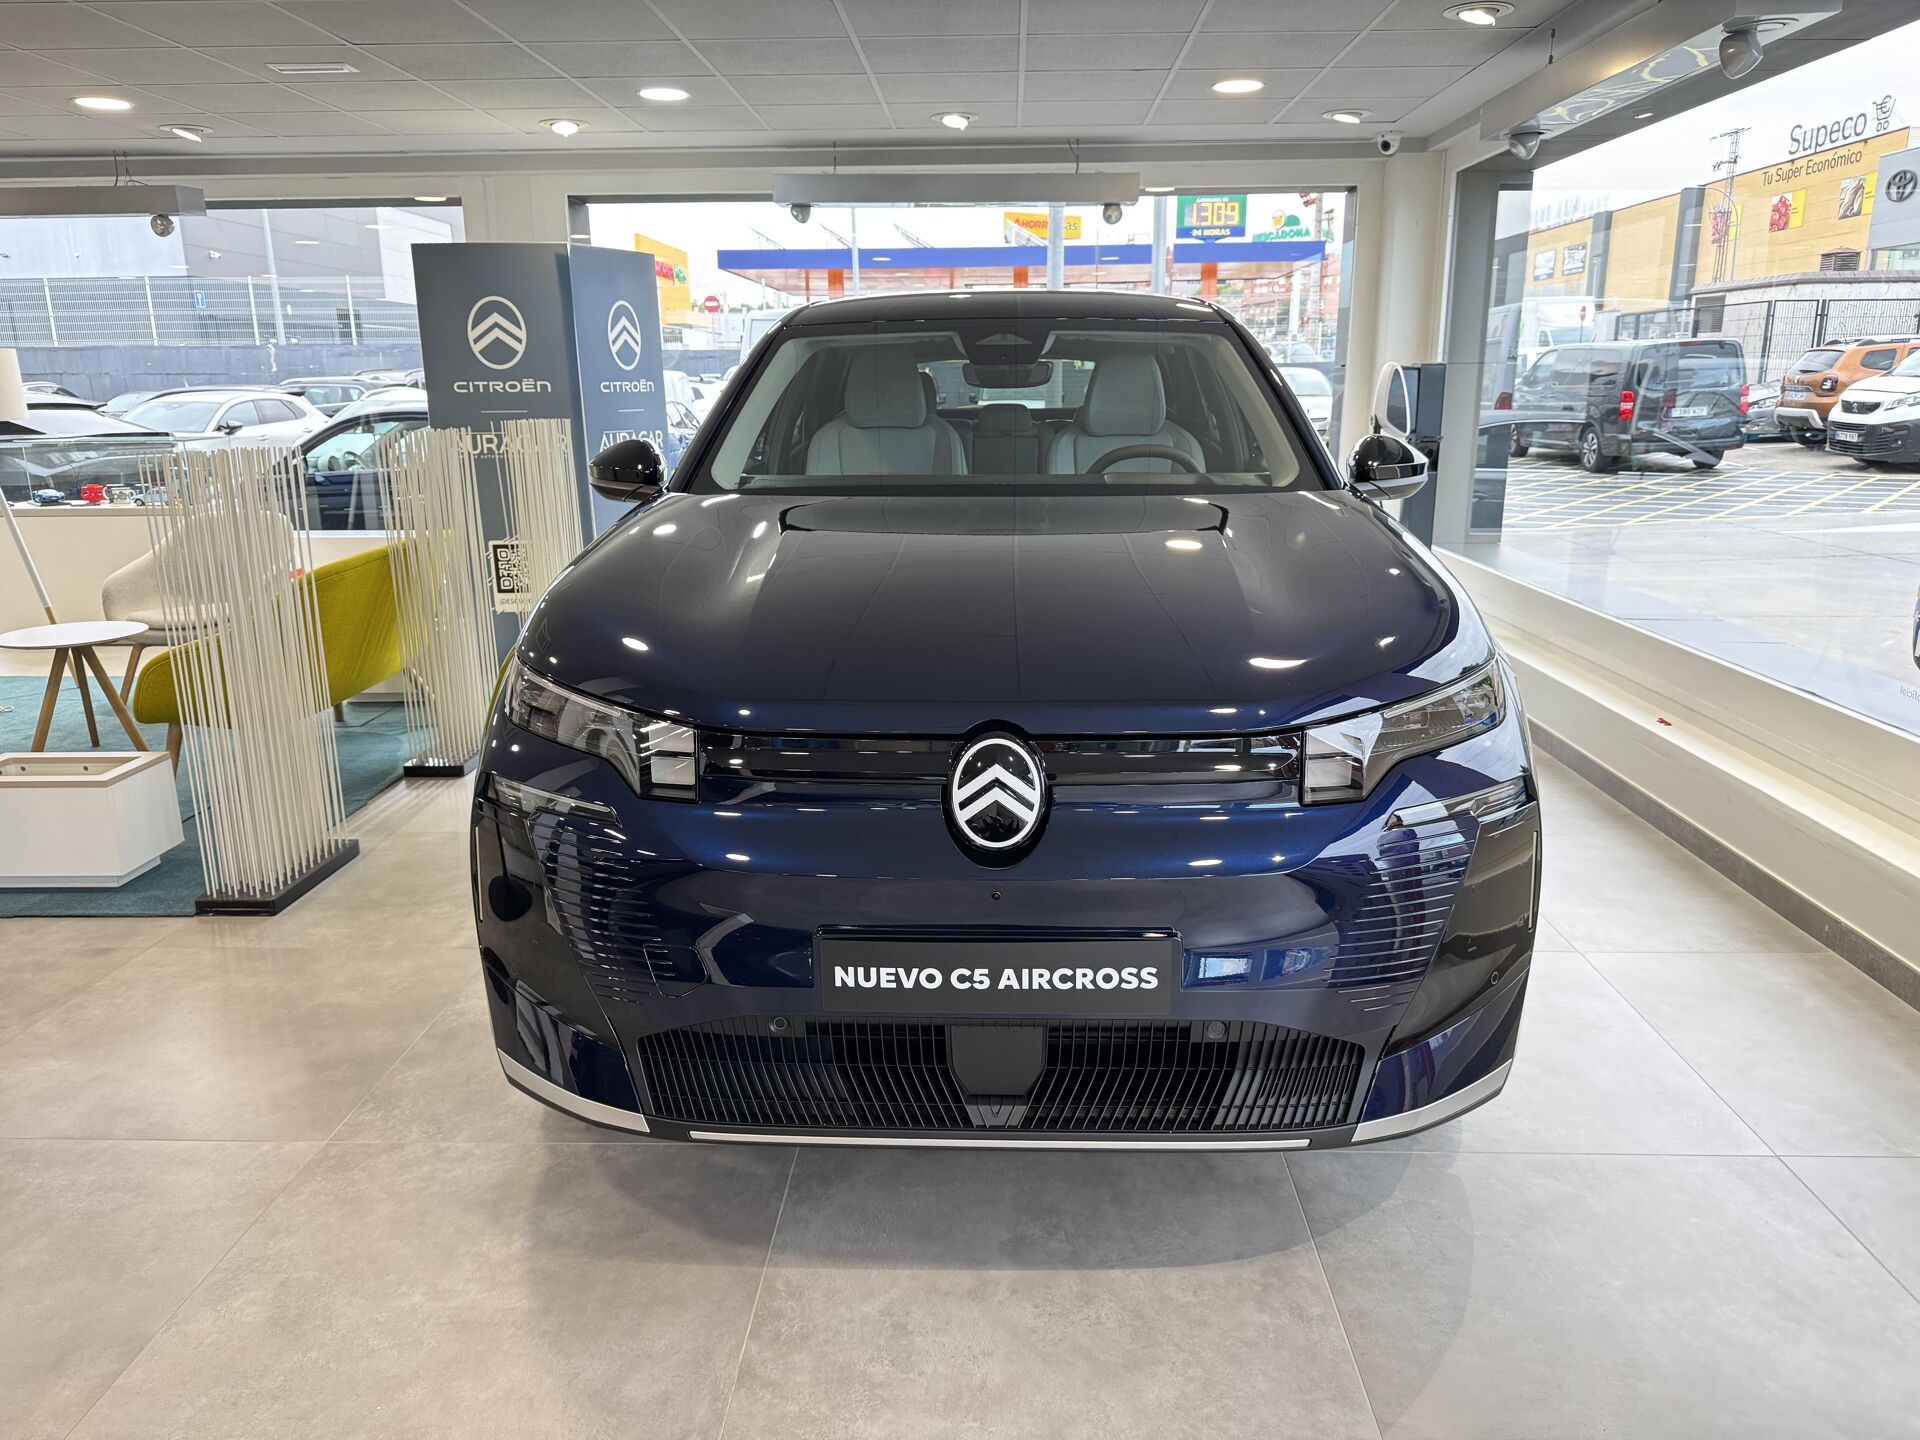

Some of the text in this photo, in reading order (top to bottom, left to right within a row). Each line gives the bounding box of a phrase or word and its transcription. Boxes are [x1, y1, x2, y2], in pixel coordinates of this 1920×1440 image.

[1788, 113, 1867, 155] Supeco
[1762, 149, 1862, 186] Tu Super Económico
[1203, 228, 1230, 236] HORAS
[834, 966, 1159, 990] NUEVO C5 AIRCROSS
